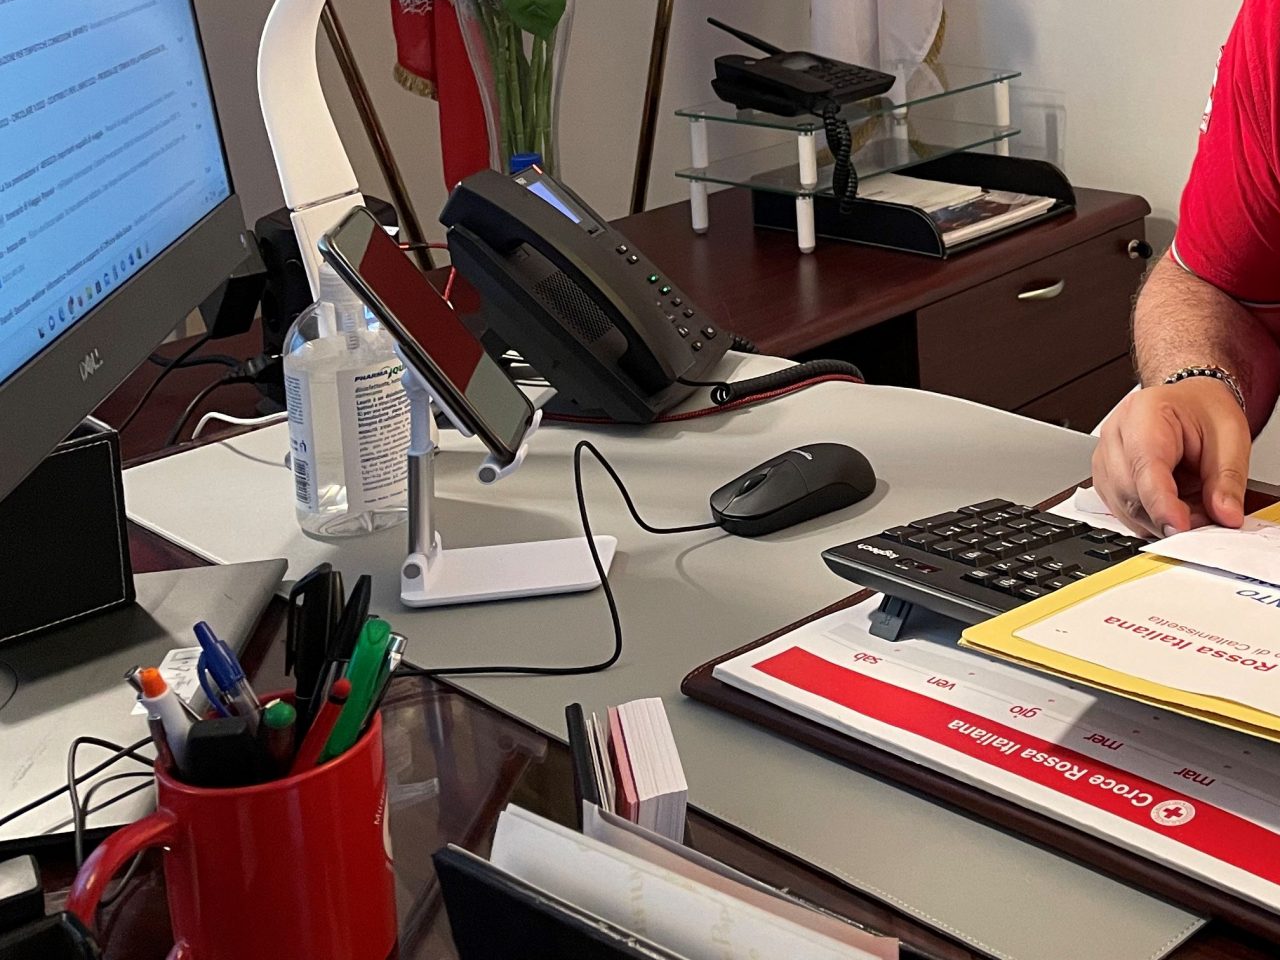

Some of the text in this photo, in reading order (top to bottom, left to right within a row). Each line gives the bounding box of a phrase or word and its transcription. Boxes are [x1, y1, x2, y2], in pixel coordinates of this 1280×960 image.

[1103, 615, 1192, 650] Italiana
[1147, 614, 1252, 652] Caltanissetta
[853, 651, 884, 666] sab
[1196, 644, 1279, 673] Rossa
[1251, 647, 1271, 657] di
[926, 674, 957, 691] ven
[1009, 704, 1043, 719] gio
[1083, 732, 1125, 752] mer
[947, 719, 1154, 808] Croce Rossa Italiana
[1173, 767, 1217, 787] mar
